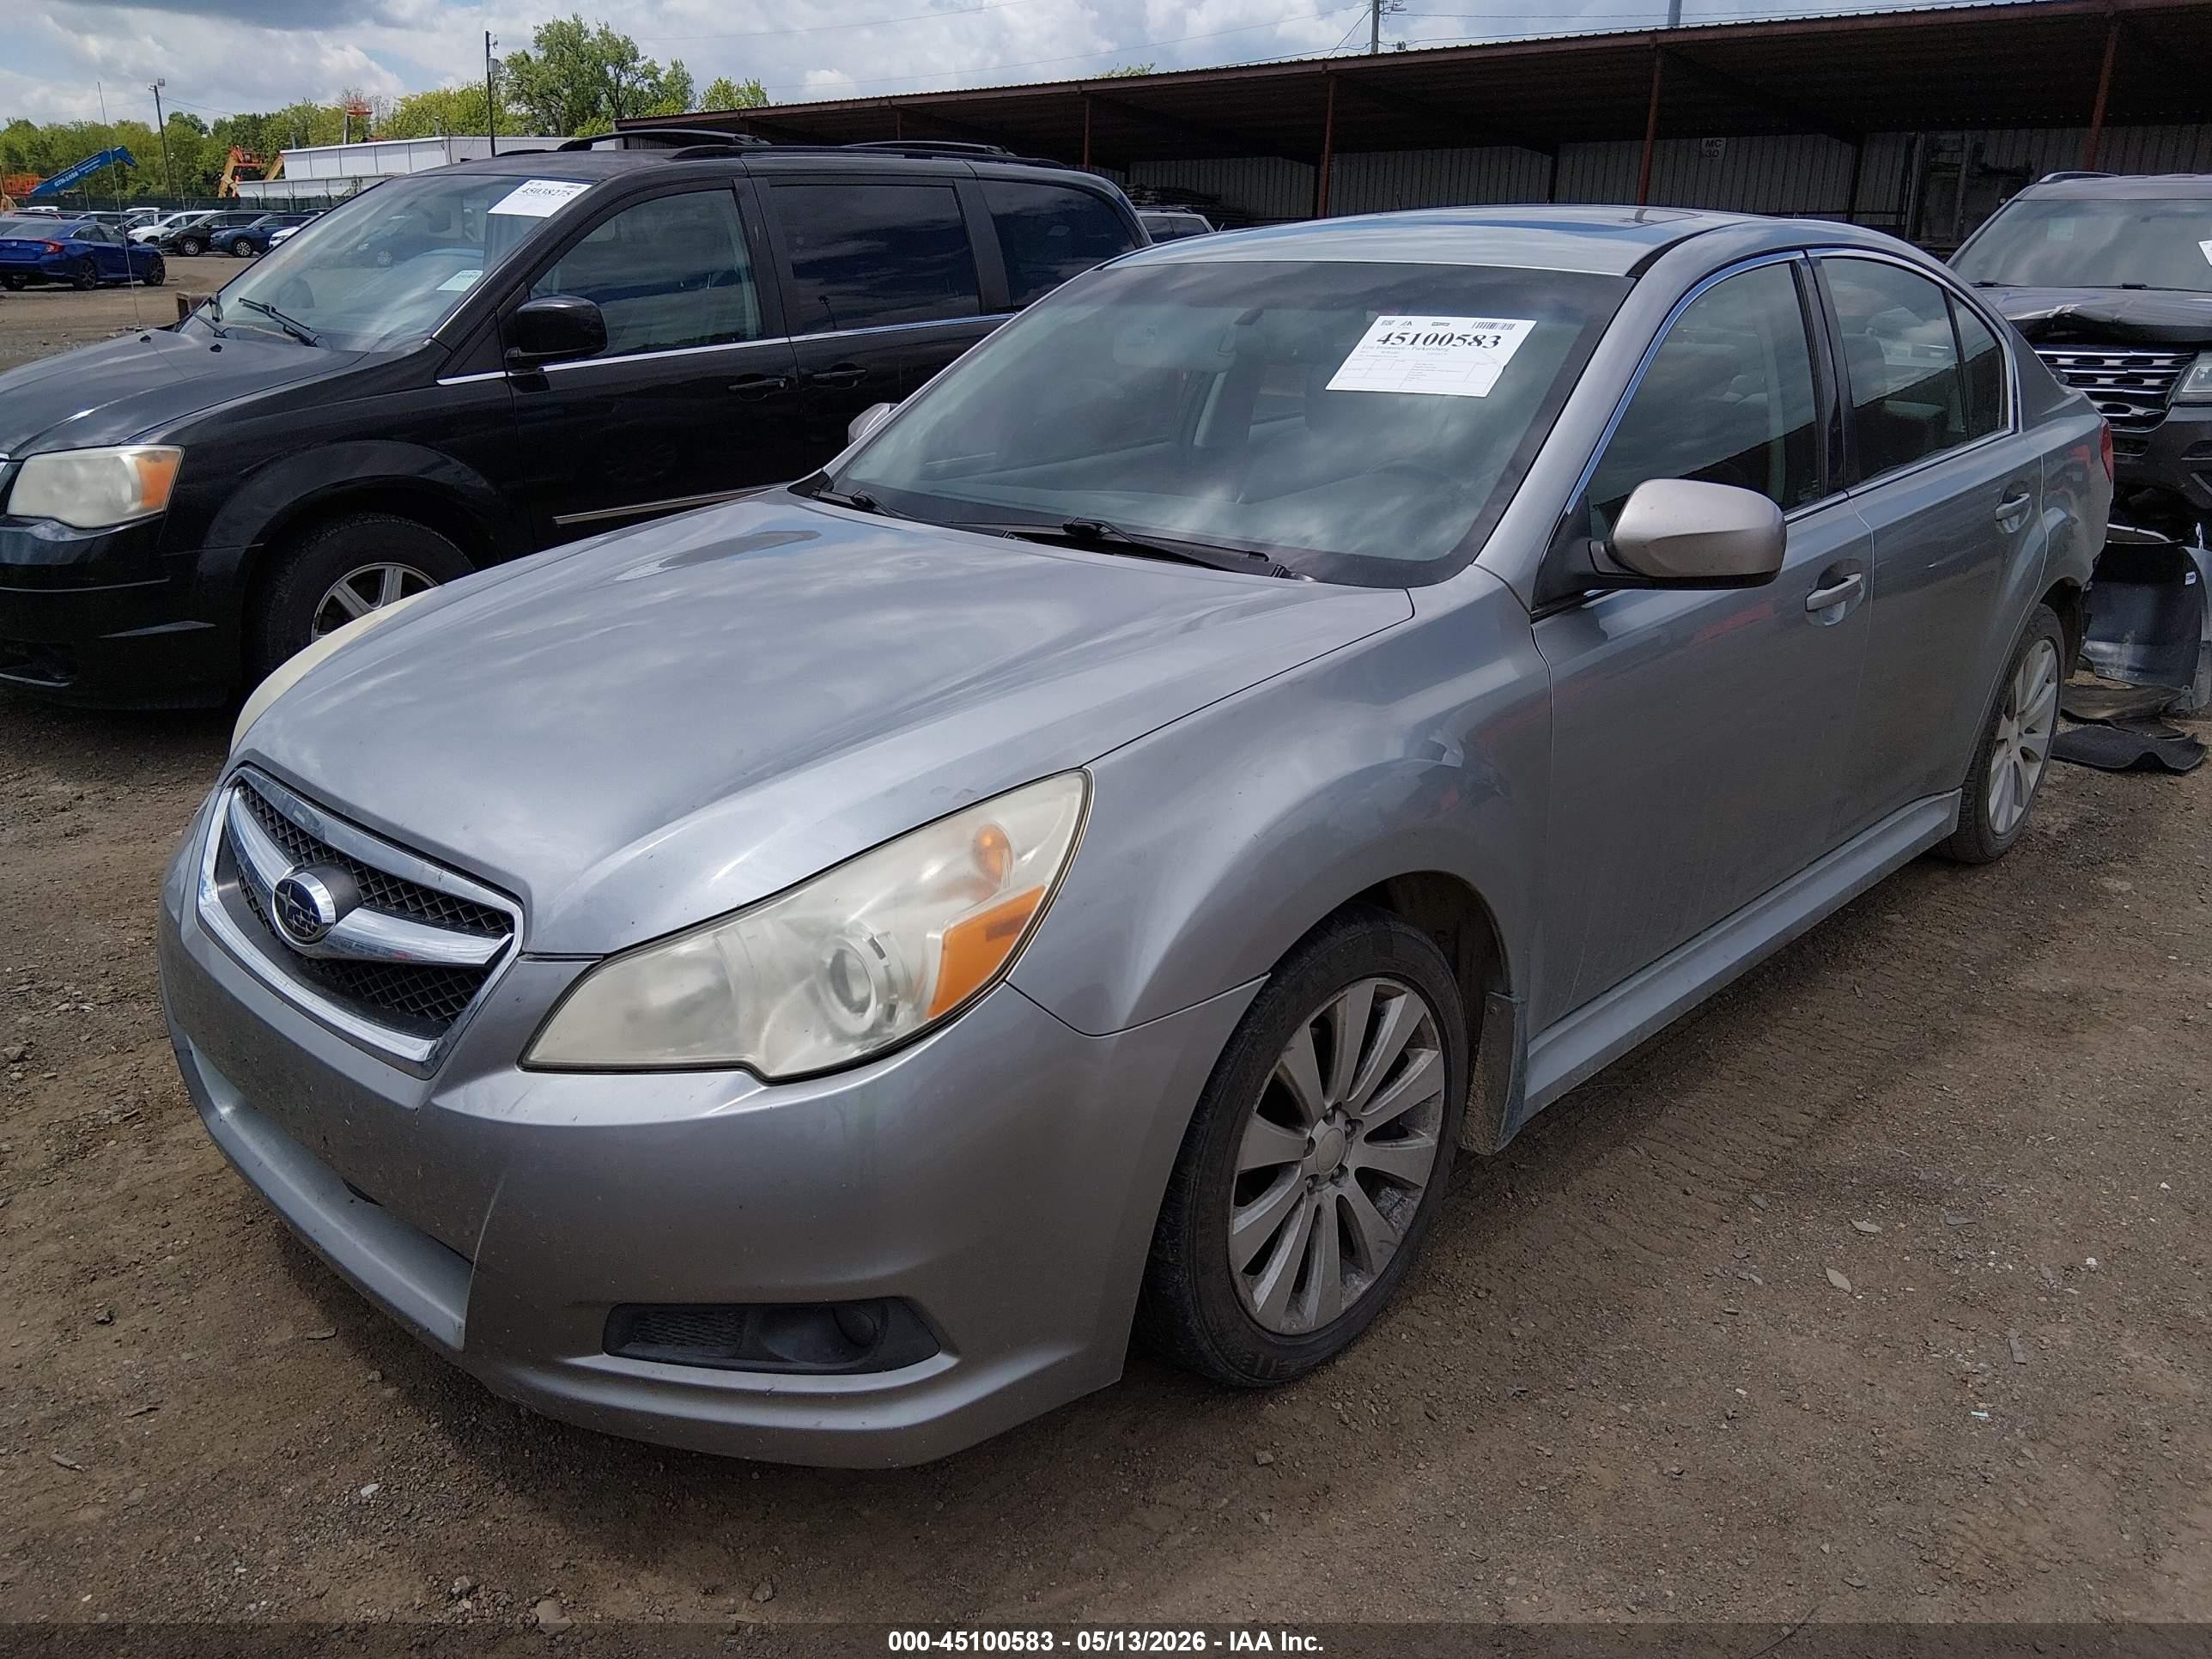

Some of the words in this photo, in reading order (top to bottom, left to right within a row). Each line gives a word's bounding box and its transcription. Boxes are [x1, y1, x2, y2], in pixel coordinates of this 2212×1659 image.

[1705, 138, 1722, 148] MC
[1705, 149, 1719, 158] 30
[1376, 331, 1502, 349] 45100583
